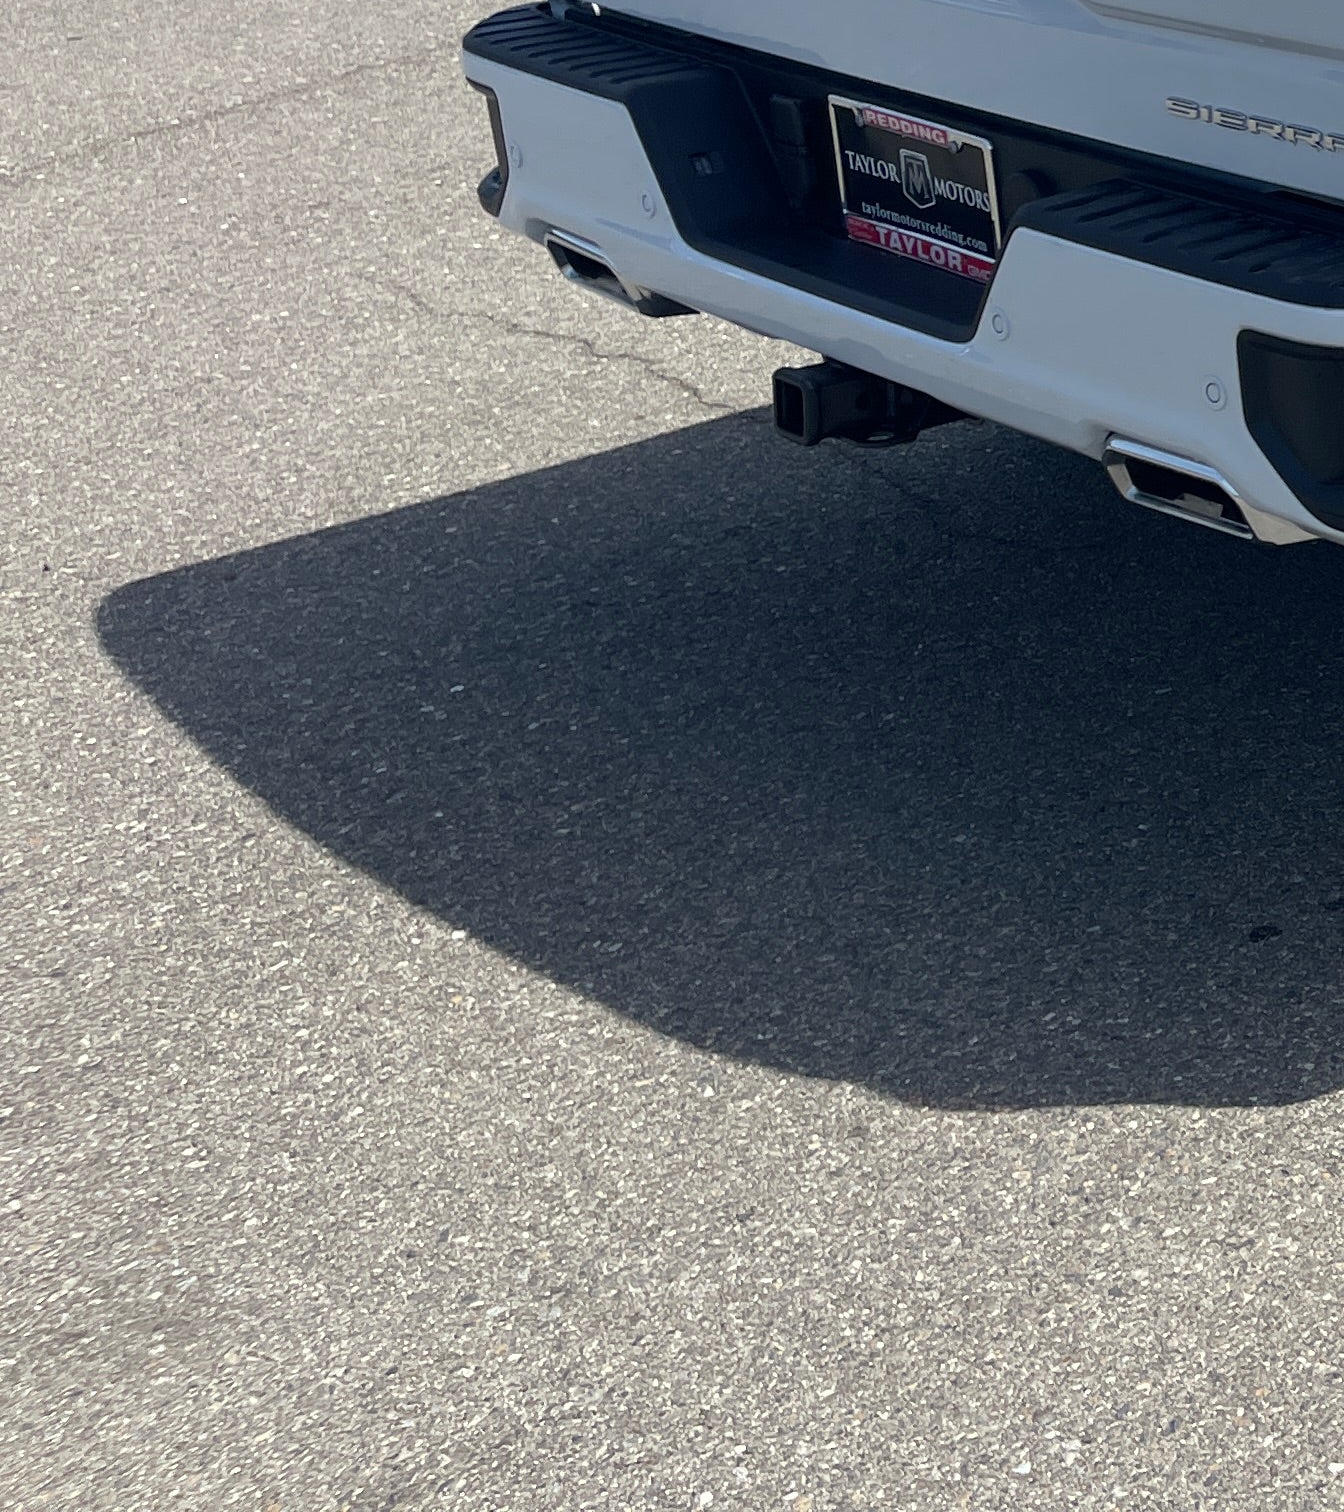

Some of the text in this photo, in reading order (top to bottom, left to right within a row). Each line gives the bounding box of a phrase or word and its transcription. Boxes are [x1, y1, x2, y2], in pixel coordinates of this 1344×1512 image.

[865, 112, 945, 145] REDDING
[844, 150, 901, 184] TAYLOR
[934, 176, 991, 212] MOTORS
[861, 201, 988, 252] taylormotorsredding.com
[875, 226, 963, 272] TAYLOR
